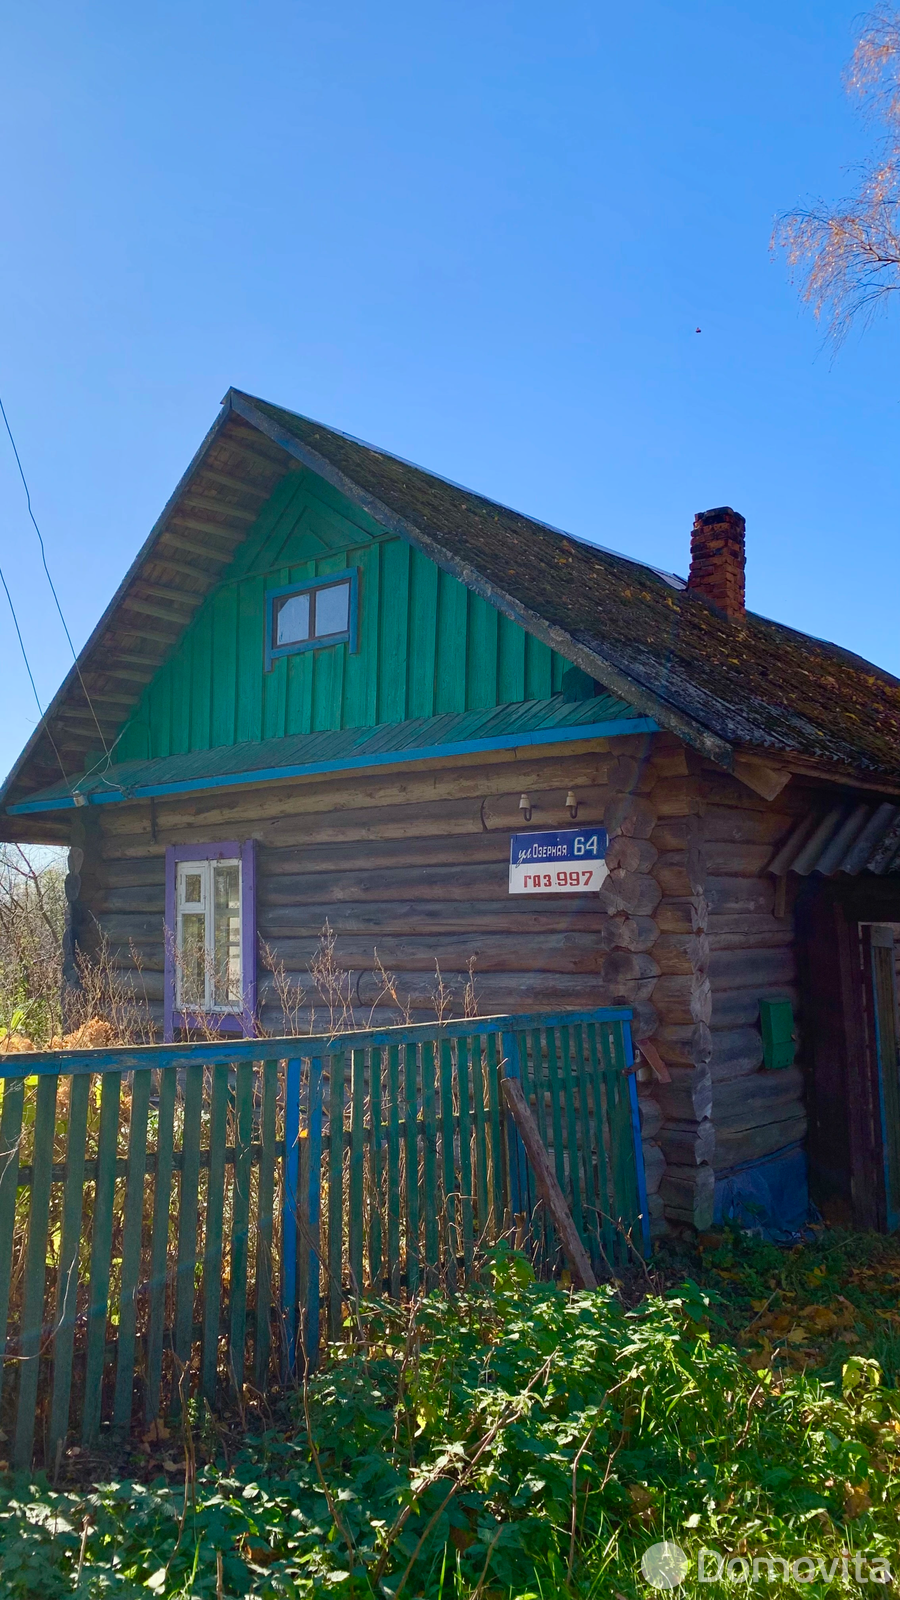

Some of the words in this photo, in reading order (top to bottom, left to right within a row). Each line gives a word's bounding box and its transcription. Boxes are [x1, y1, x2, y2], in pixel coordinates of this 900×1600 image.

[574, 835, 598, 855] 64
[523, 874, 552, 888] ГАЗ
[556, 870, 593, 886] 997
